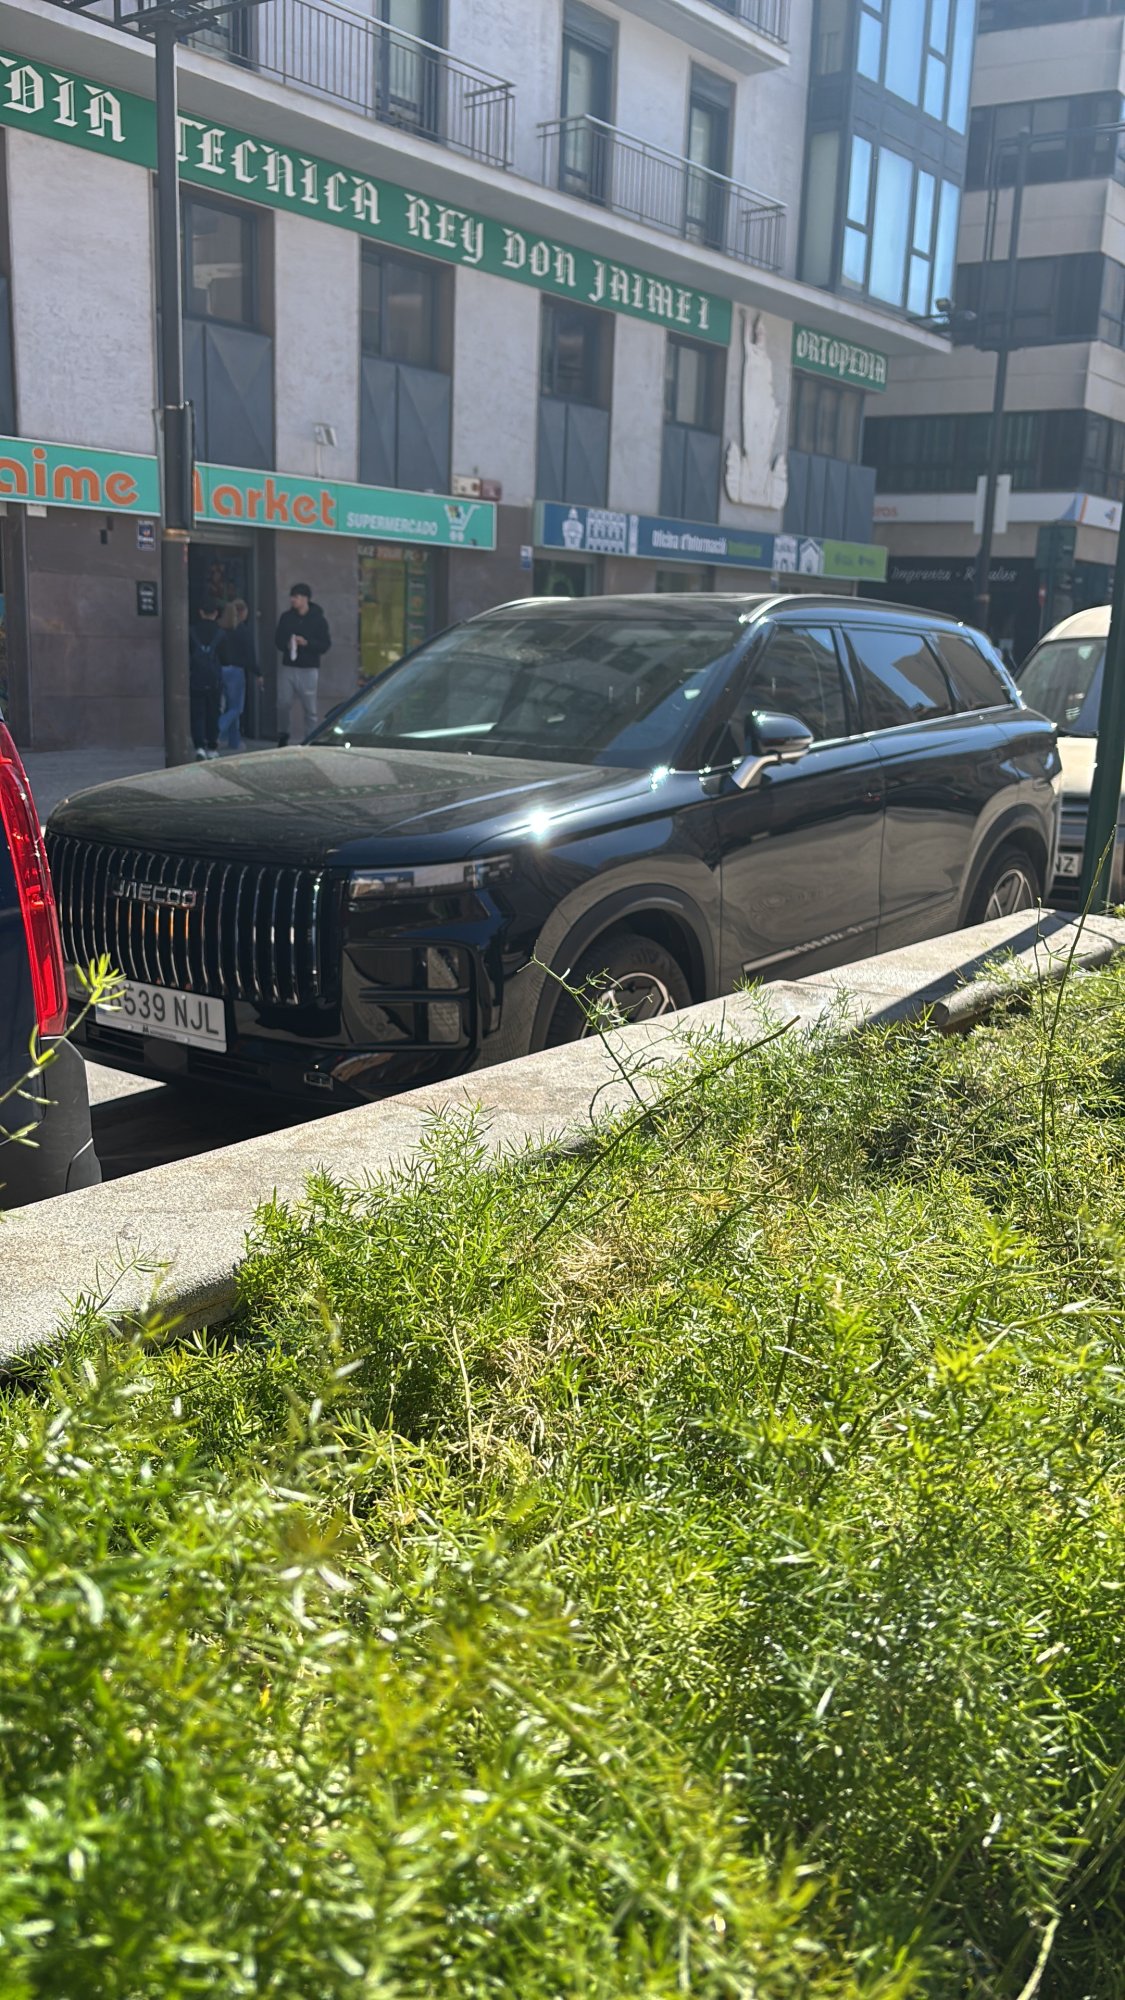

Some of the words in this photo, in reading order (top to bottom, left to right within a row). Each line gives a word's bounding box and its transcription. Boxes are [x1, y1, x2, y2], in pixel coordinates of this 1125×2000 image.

[177, 117, 382, 224] TECNICA
[404, 193, 484, 263] REY
[502, 228, 577, 288] DON
[588, 260, 692, 325] JAIME
[797, 330, 887, 384] ORTOPEDIA
[194, 470, 336, 528] arket
[346, 511, 438, 536] SUPERMERCADO
[174, 995, 219, 1036] NJL
